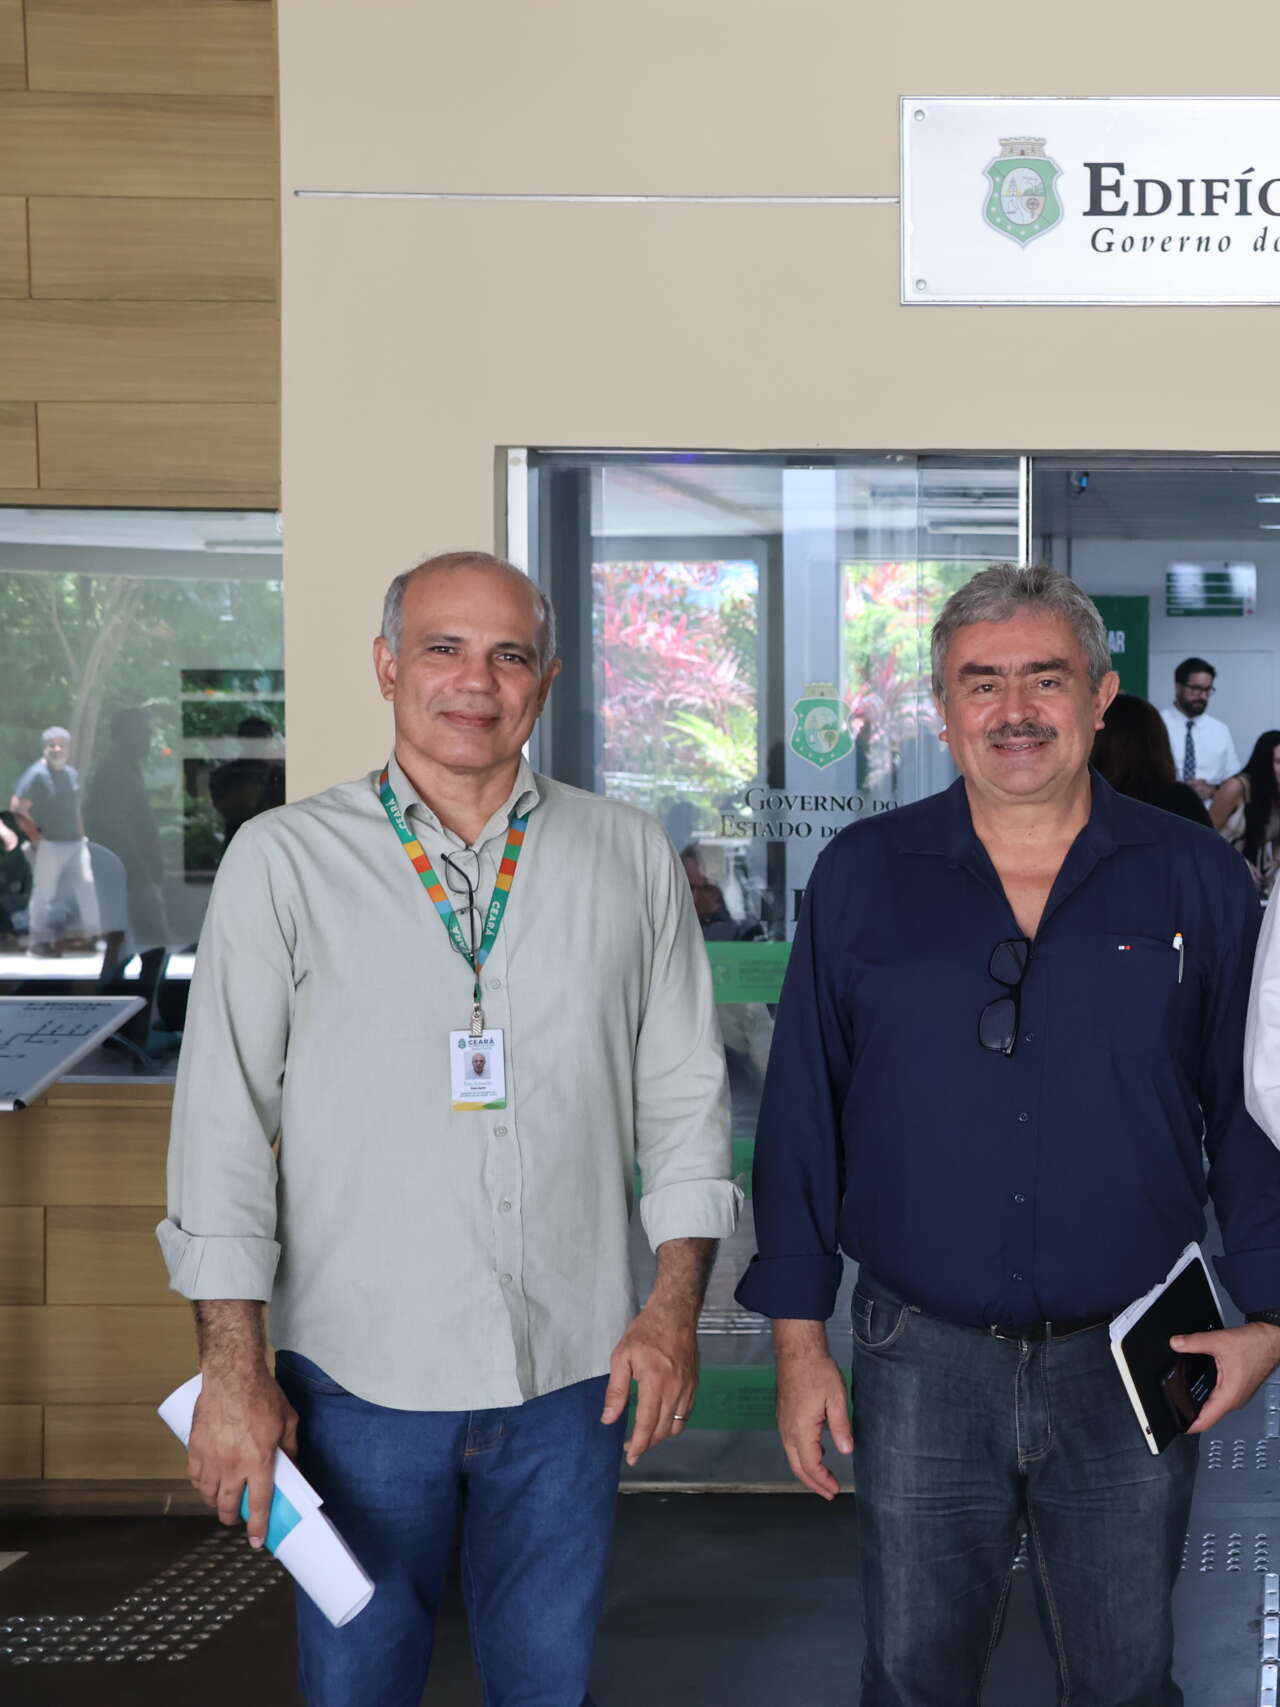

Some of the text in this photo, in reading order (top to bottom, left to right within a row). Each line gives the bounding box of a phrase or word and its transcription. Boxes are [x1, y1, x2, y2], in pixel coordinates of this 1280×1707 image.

[1091, 227, 1231, 252] Governo
[745, 788, 898, 812] GOVERNO DO
[720, 815, 812, 838] ESTADO
[485, 900, 501, 937] CEARÁ
